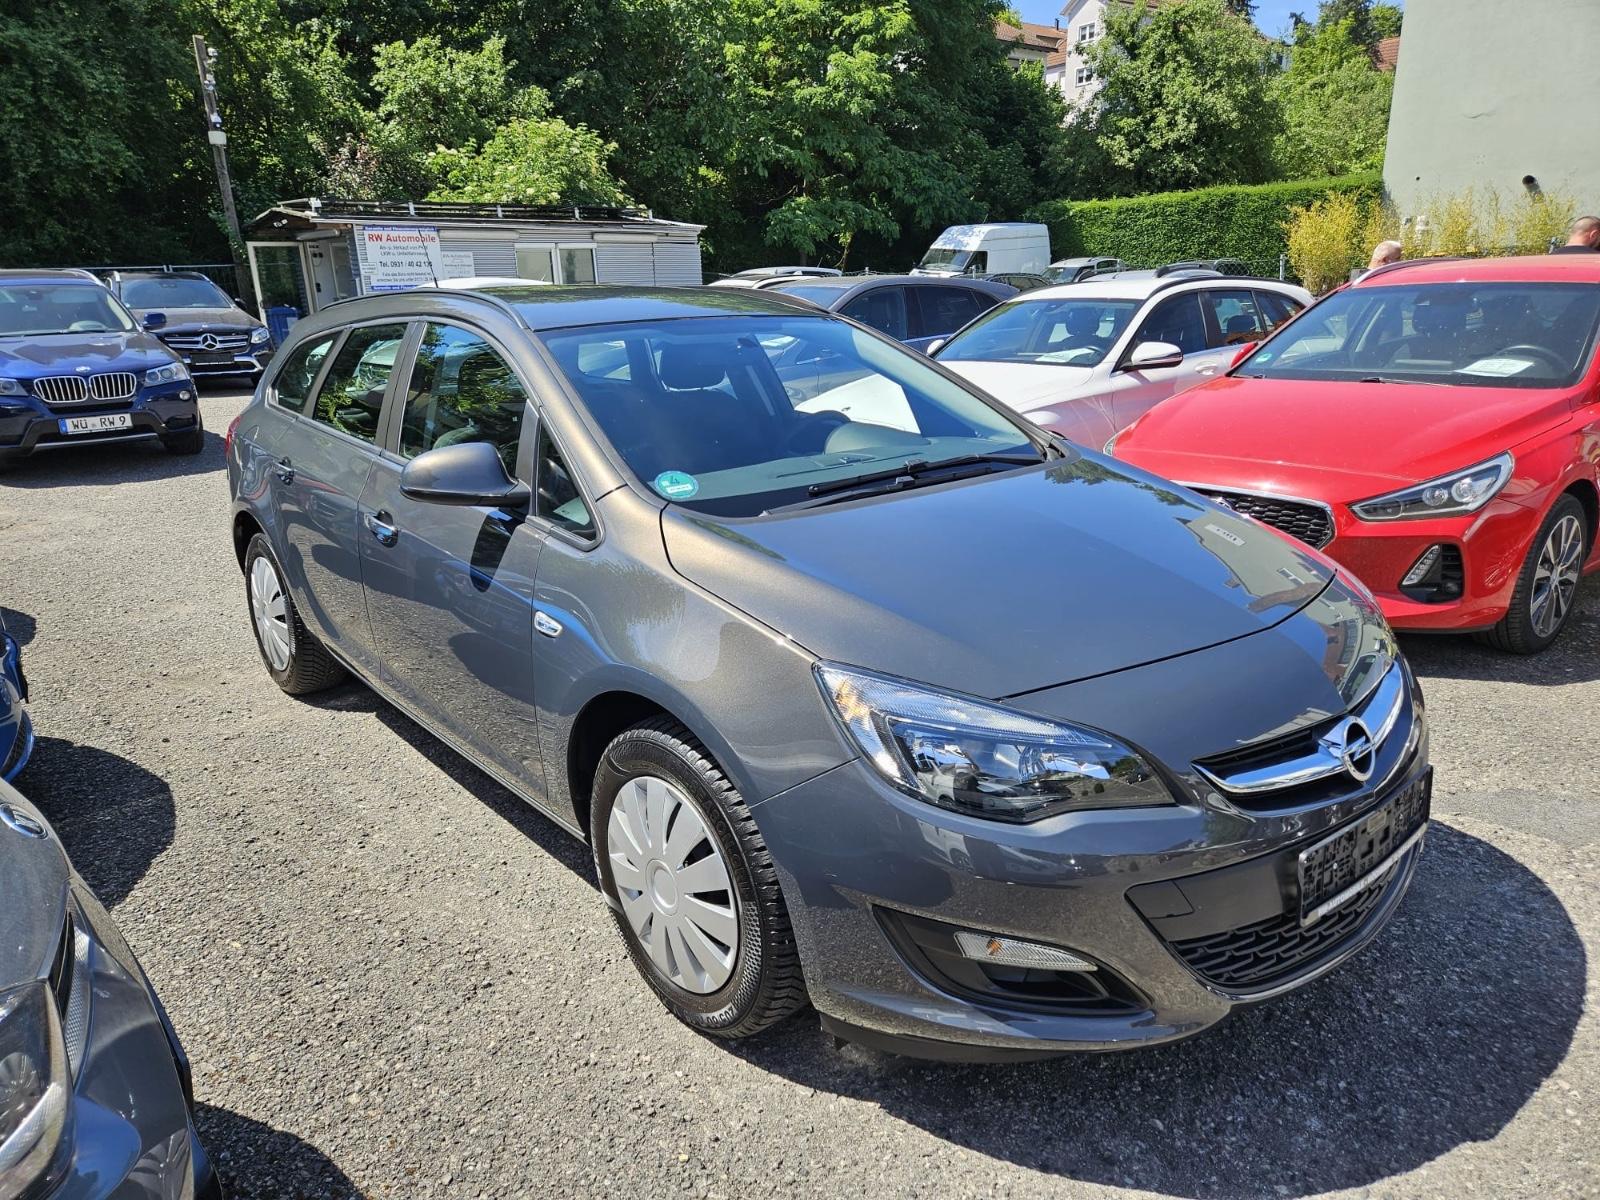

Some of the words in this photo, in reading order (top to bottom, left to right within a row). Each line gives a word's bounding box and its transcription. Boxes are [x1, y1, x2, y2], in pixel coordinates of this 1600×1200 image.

[368, 233, 383, 242] RW
[386, 233, 436, 243] Automobile
[71, 419, 88, 430] WÜ
[100, 417, 115, 428] RW
[119, 416, 126, 426] 9
